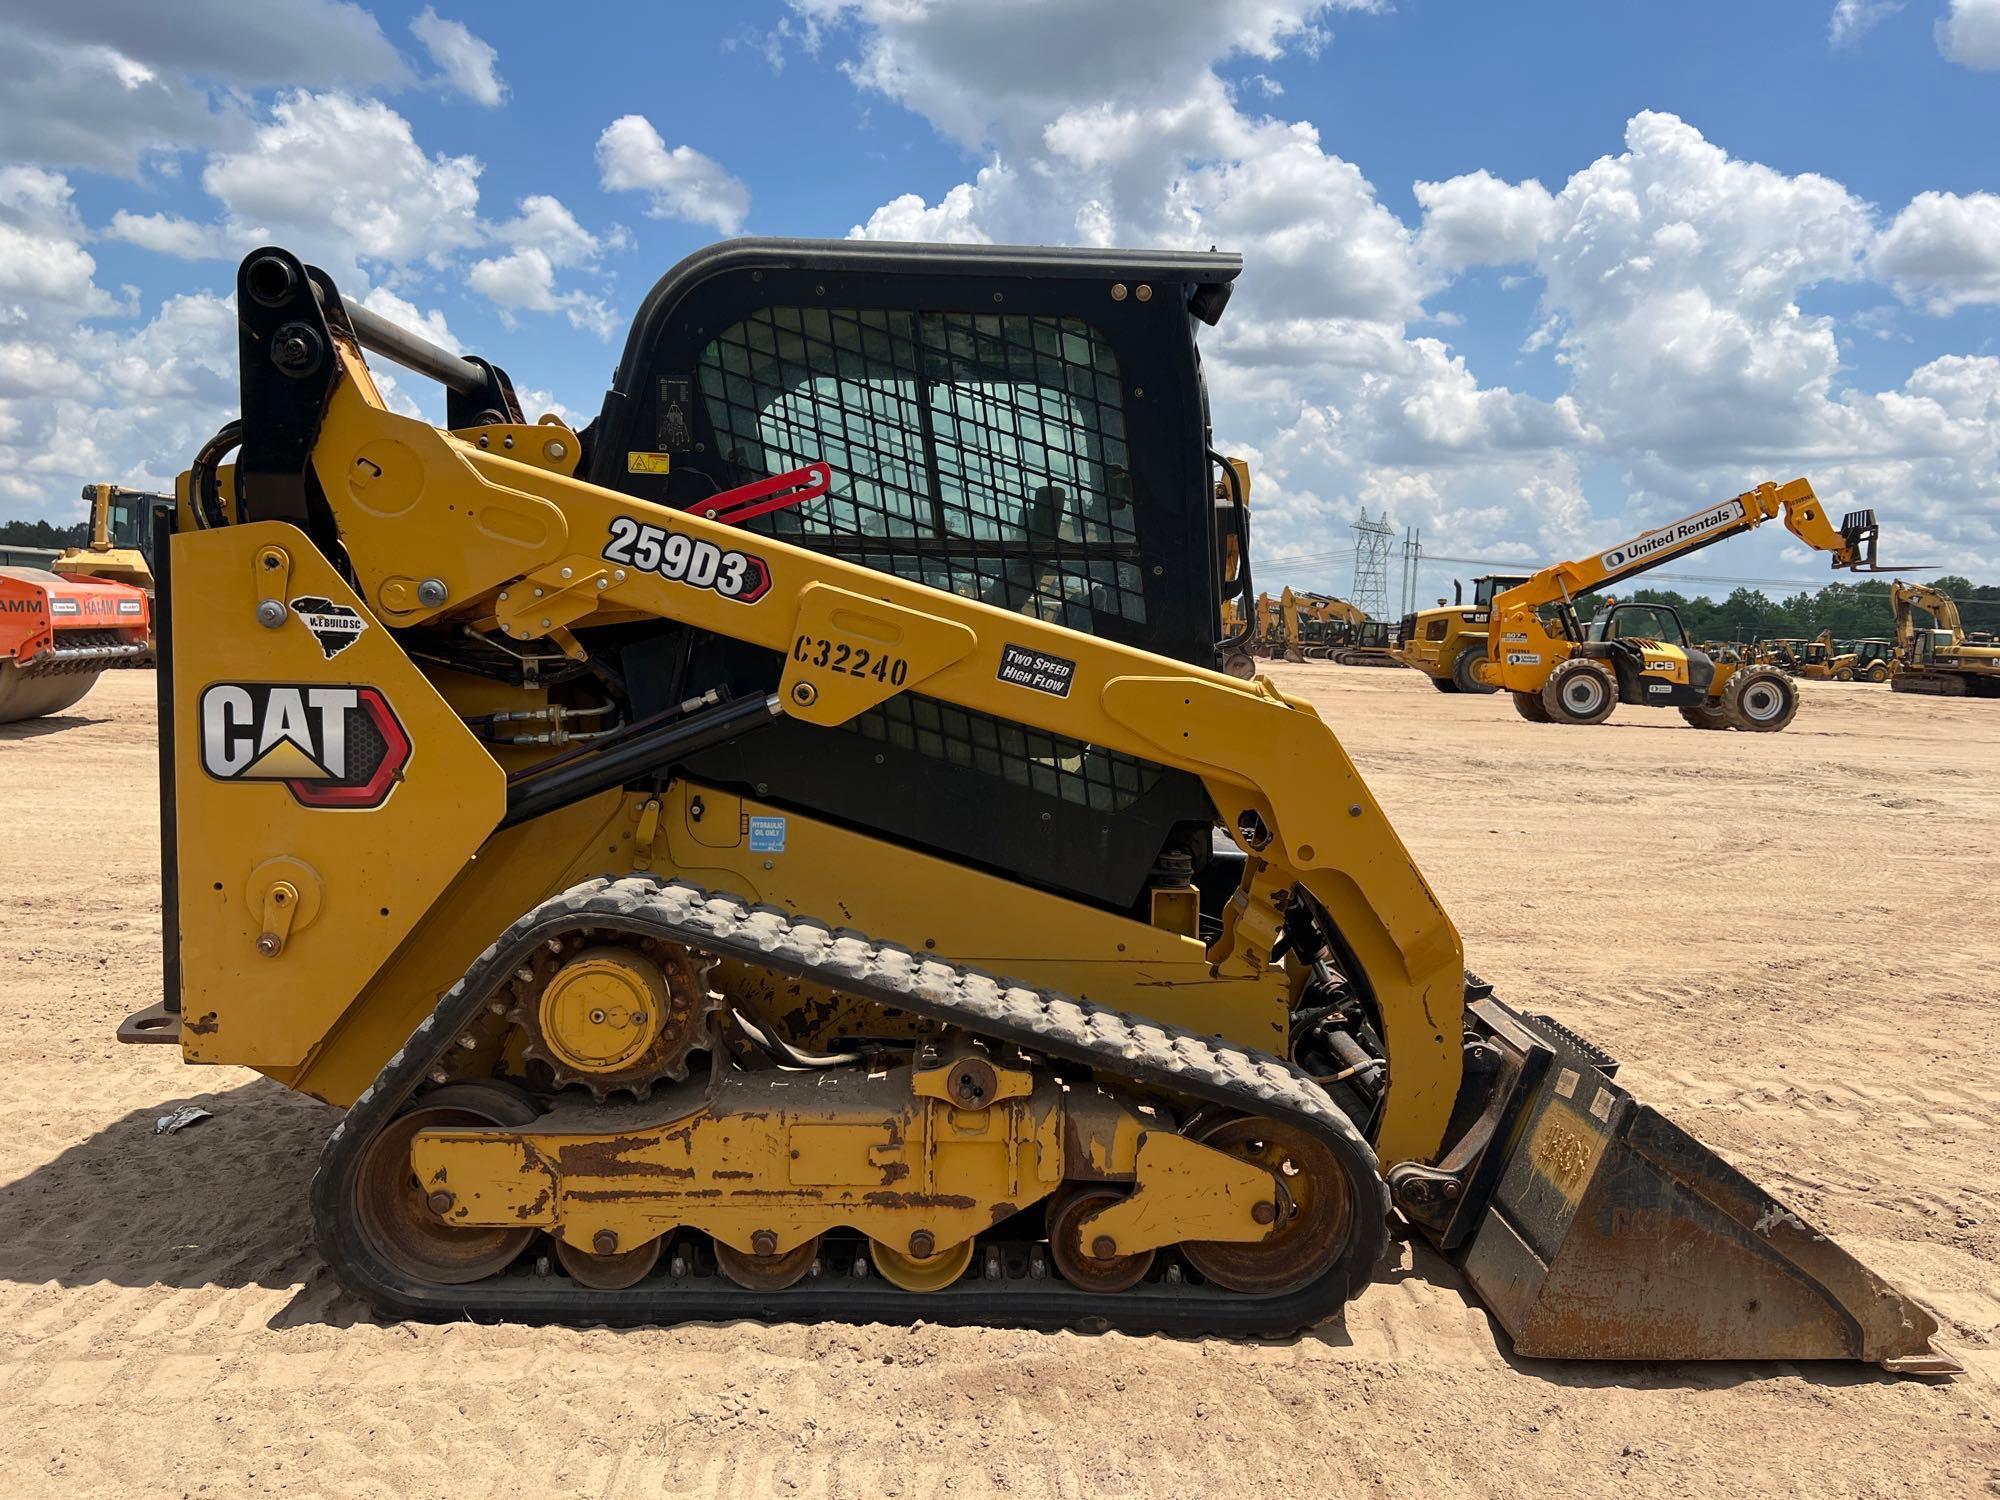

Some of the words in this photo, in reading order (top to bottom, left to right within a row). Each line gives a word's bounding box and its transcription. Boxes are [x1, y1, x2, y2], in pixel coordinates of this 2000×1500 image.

[1627, 530, 1675, 558] United
[1677, 509, 1730, 538] Rentals
[604, 518, 748, 595] 259D3
[83, 600, 115, 615] HAMM
[324, 619, 348, 628] BUILD
[349, 620, 360, 629] SC
[1474, 613, 1489, 622] CAT
[794, 635, 908, 686] C32240
[1645, 661, 1675, 670] JCB
[203, 684, 358, 779] CAT
[752, 821, 784, 829] HYDRAULIC
